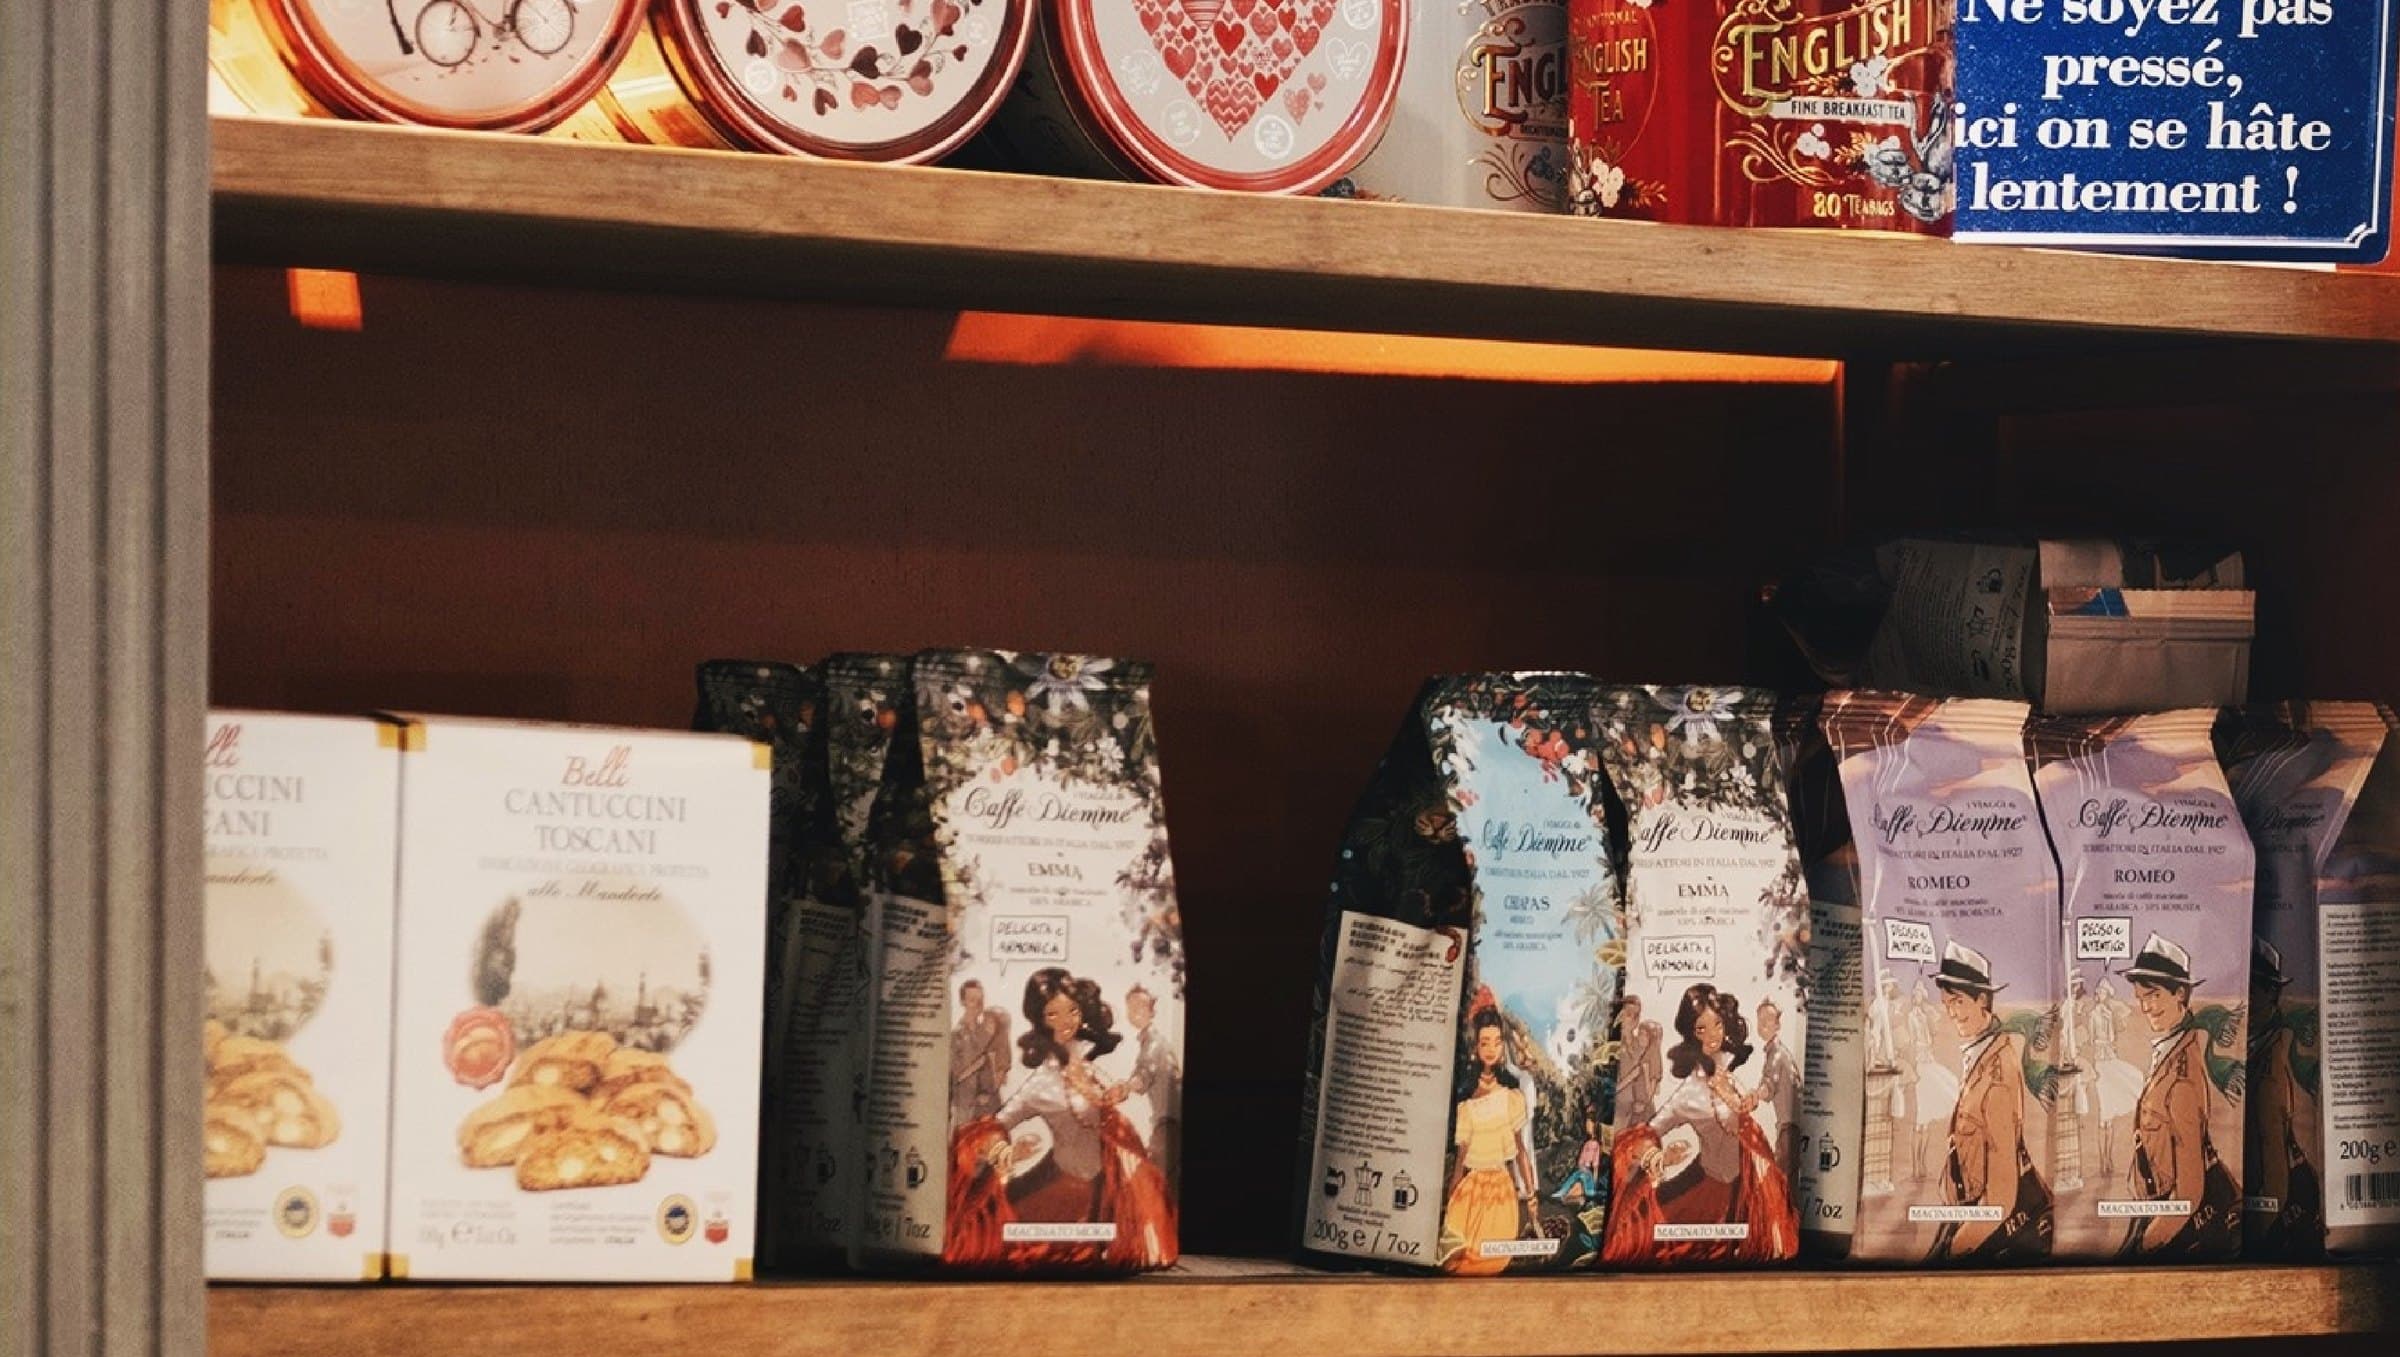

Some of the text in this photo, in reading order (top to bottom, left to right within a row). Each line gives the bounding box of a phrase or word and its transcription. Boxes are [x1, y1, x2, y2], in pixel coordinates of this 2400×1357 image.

[2062, 0, 2219, 37] soyez
[2237, 0, 2333, 38] pas
[1727, 0, 1911, 98] ENGLISH
[2041, 38, 2244, 100] pressé,
[1578, 79, 1624, 131] TEA
[1790, 100, 1906, 120] FINE BREAKFAST TEA
[1955, 101, 2332, 151] ici on se hâte
[1813, 191, 1841, 218] 80
[1968, 161, 2299, 214] lentement !
[561, 745, 633, 788] Belli
[204, 809, 272, 837] ANI
[504, 787, 688, 823] CANTUCCINI
[1028, 792, 1133, 831] Diemme
[1917, 803, 2024, 841] Diemme
[2129, 800, 2229, 836] Diemme
[534, 824, 658, 855] TOSCANI
[1512, 822, 1589, 860] Diemme
[1681, 813, 1771, 851] Diemme
[1027, 862, 1083, 881] EMMA
[1907, 874, 1971, 891] ROMEO
[2113, 868, 2176, 884] ROMEO
[1677, 882, 1730, 898] EMMA
[1647, 941, 1703, 956] DELICATA
[1651, 958, 1710, 973] ARMONICA
[2339, 1139, 2380, 1166] 200g
[1388, 1232, 1420, 1256] 7oz
